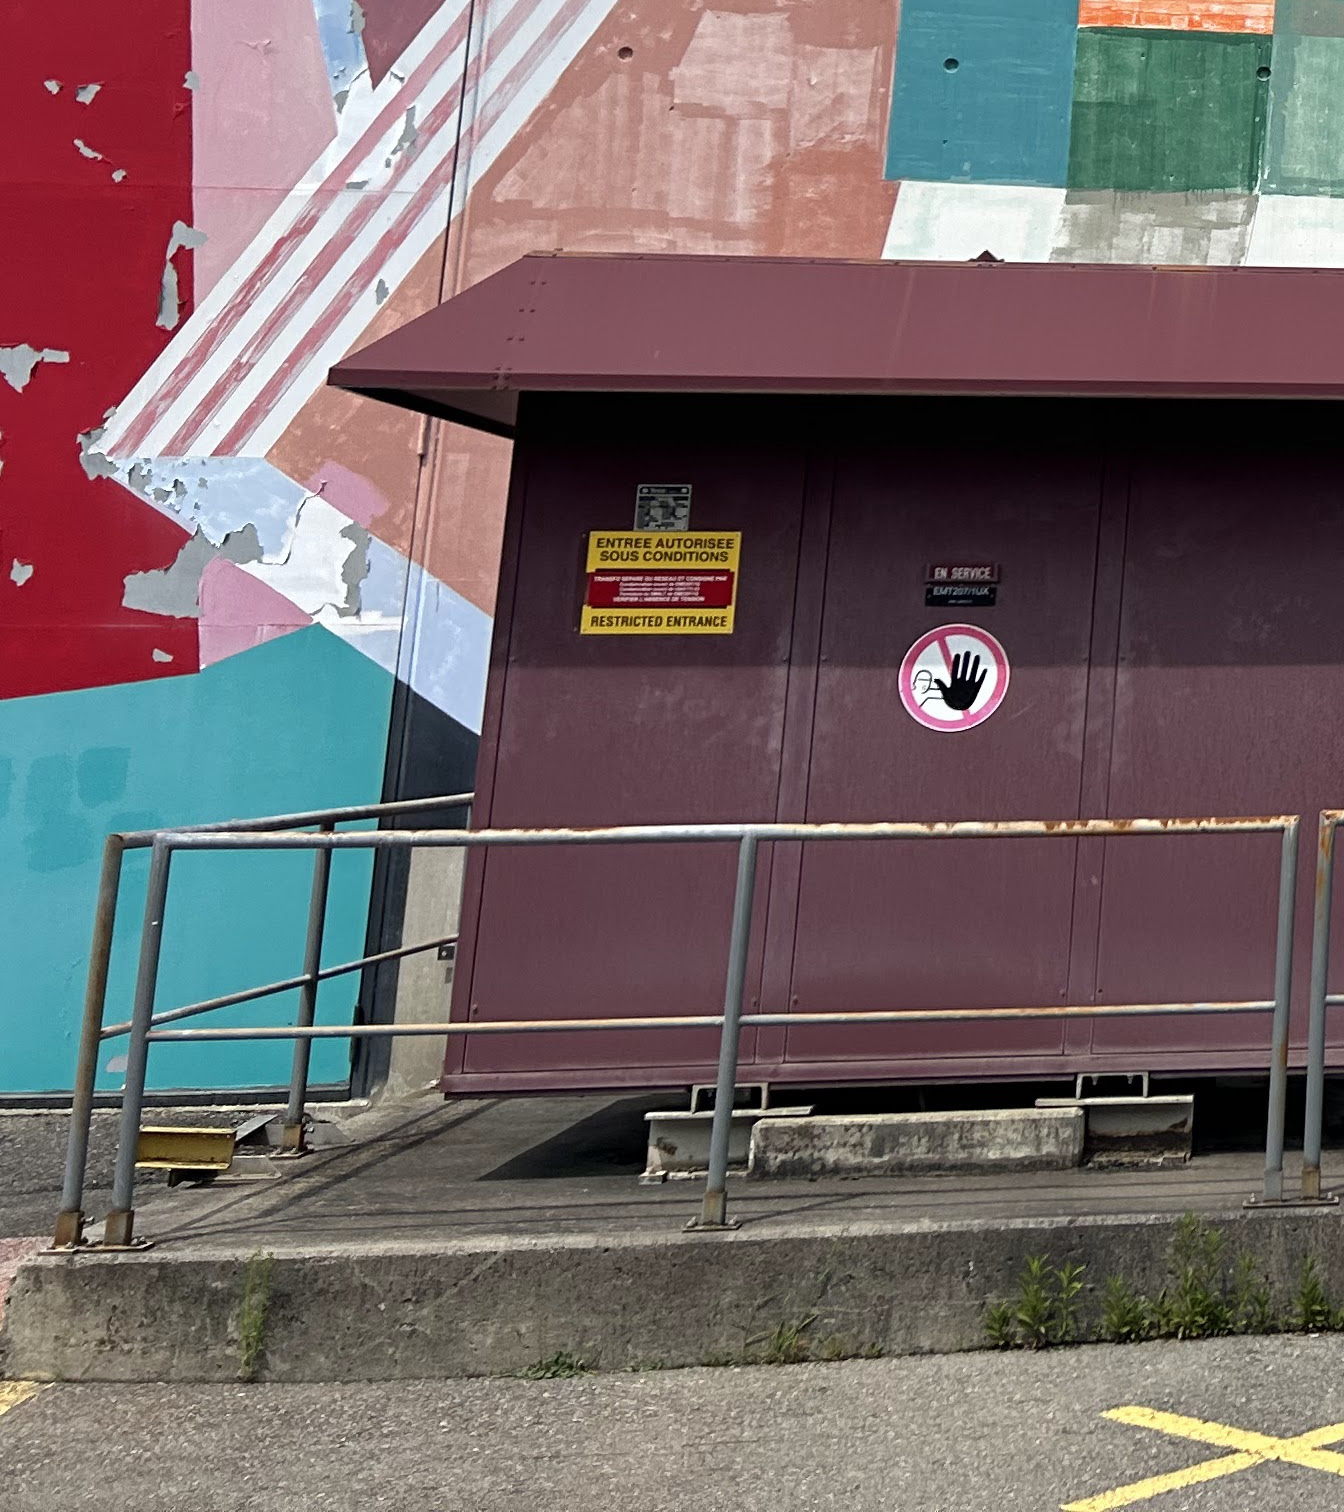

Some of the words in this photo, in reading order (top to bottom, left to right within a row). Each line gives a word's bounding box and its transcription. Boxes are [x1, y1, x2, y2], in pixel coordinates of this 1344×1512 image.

[596, 538, 651, 549] ENTREE
[655, 538, 735, 549] AUTORISEE
[600, 550, 639, 562] SOUS
[643, 550, 729, 562] CONDITIONS
[934, 566, 948, 579] EN
[950, 566, 991, 579] SERVICE
[590, 616, 663, 627] RESTRICTED
[666, 616, 728, 627] ENTRANCE
